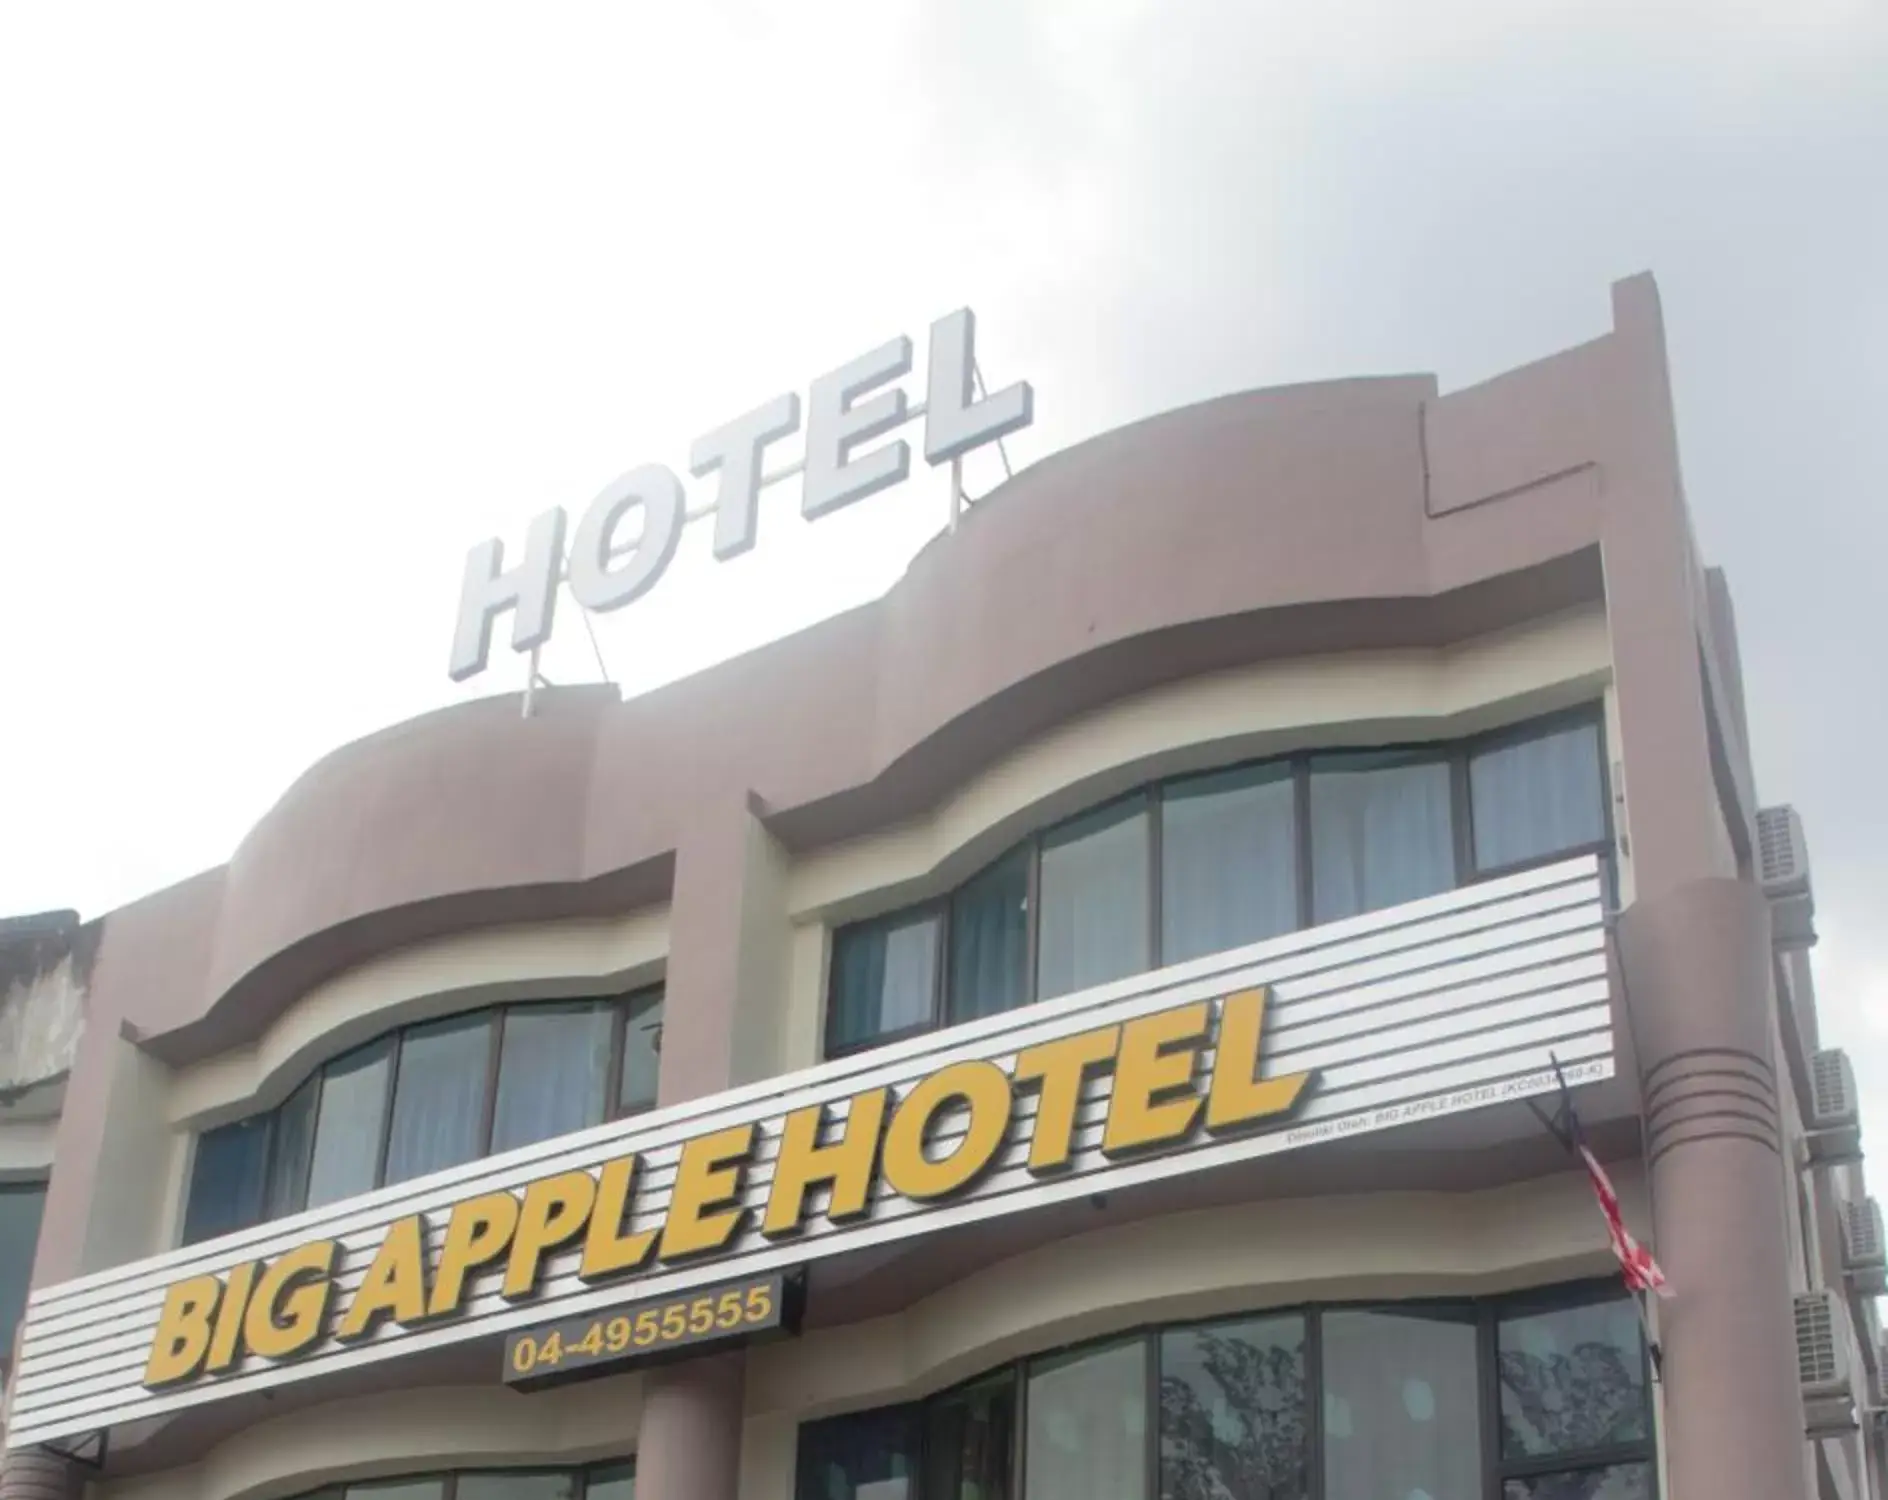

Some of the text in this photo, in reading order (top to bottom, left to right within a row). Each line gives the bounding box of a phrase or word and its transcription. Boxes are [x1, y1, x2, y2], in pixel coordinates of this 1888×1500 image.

[448, 305, 1034, 683] HOTEL
[142, 984, 1320, 1388] BIG APPLE HOTEL
[1403, 1096, 1449, 1117] APPLE
[1450, 1085, 1497, 1108] HOTEL
[512, 1284, 773, 1375] 04-4955555
